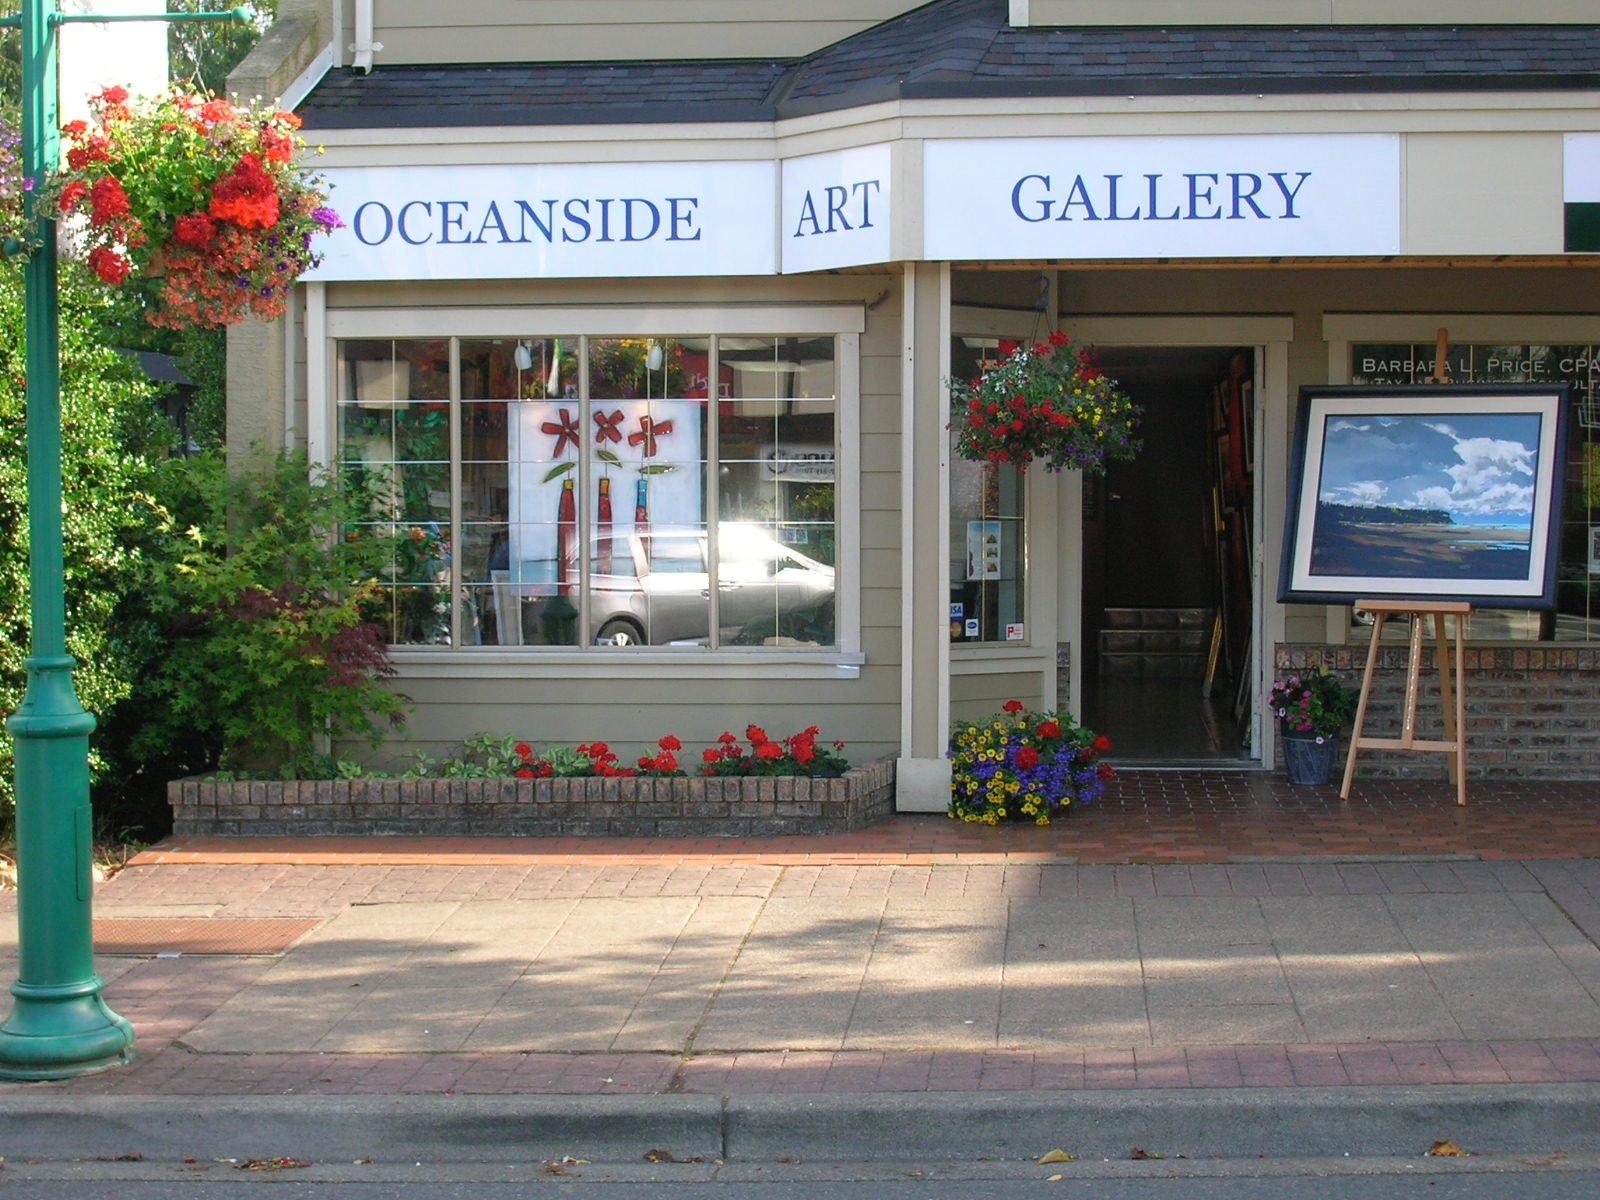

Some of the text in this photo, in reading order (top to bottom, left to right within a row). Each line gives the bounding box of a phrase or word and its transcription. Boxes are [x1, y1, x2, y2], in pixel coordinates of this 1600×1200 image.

[353, 172, 1312, 245] OCEANSIDE ART GALLERY
